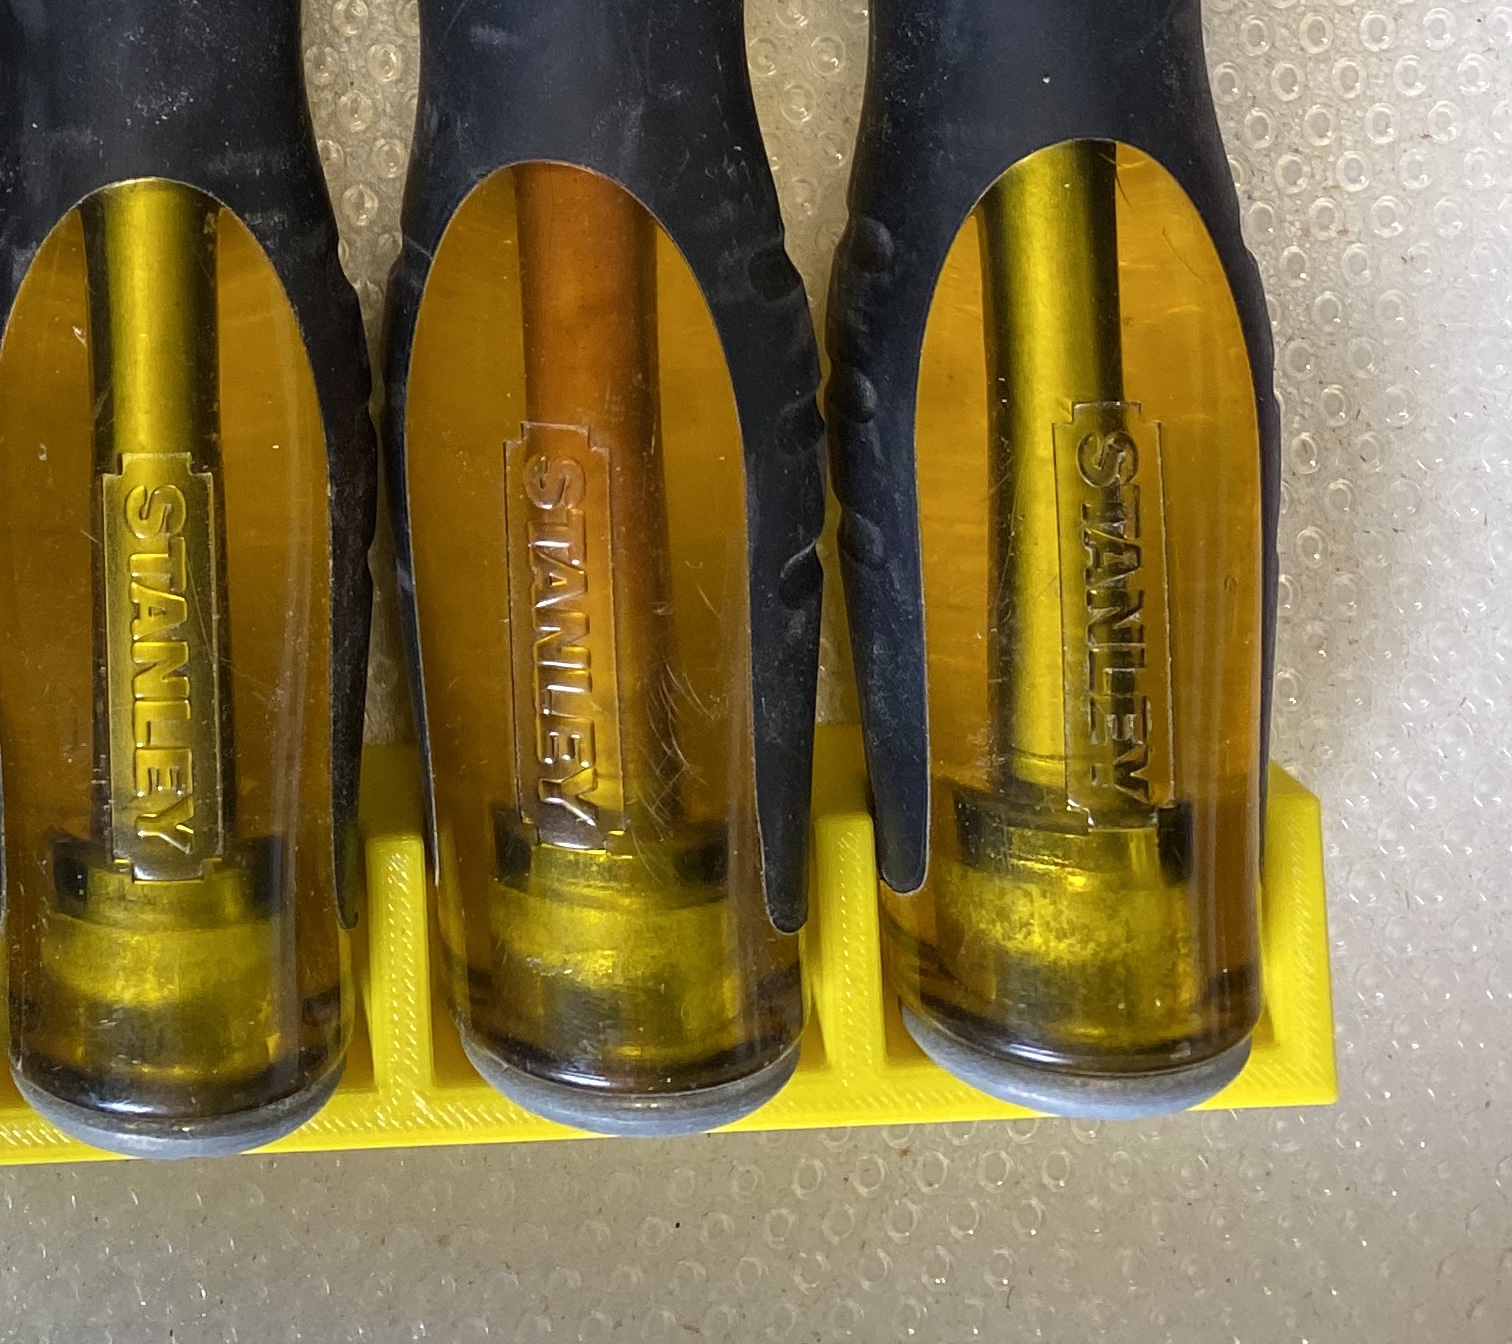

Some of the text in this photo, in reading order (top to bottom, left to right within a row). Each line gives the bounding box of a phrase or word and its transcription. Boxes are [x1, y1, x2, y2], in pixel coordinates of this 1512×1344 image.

[125, 483, 195, 854] STANLEY
[524, 455, 599, 829] STANLEY
[1076, 430, 1153, 804] STANLEY
